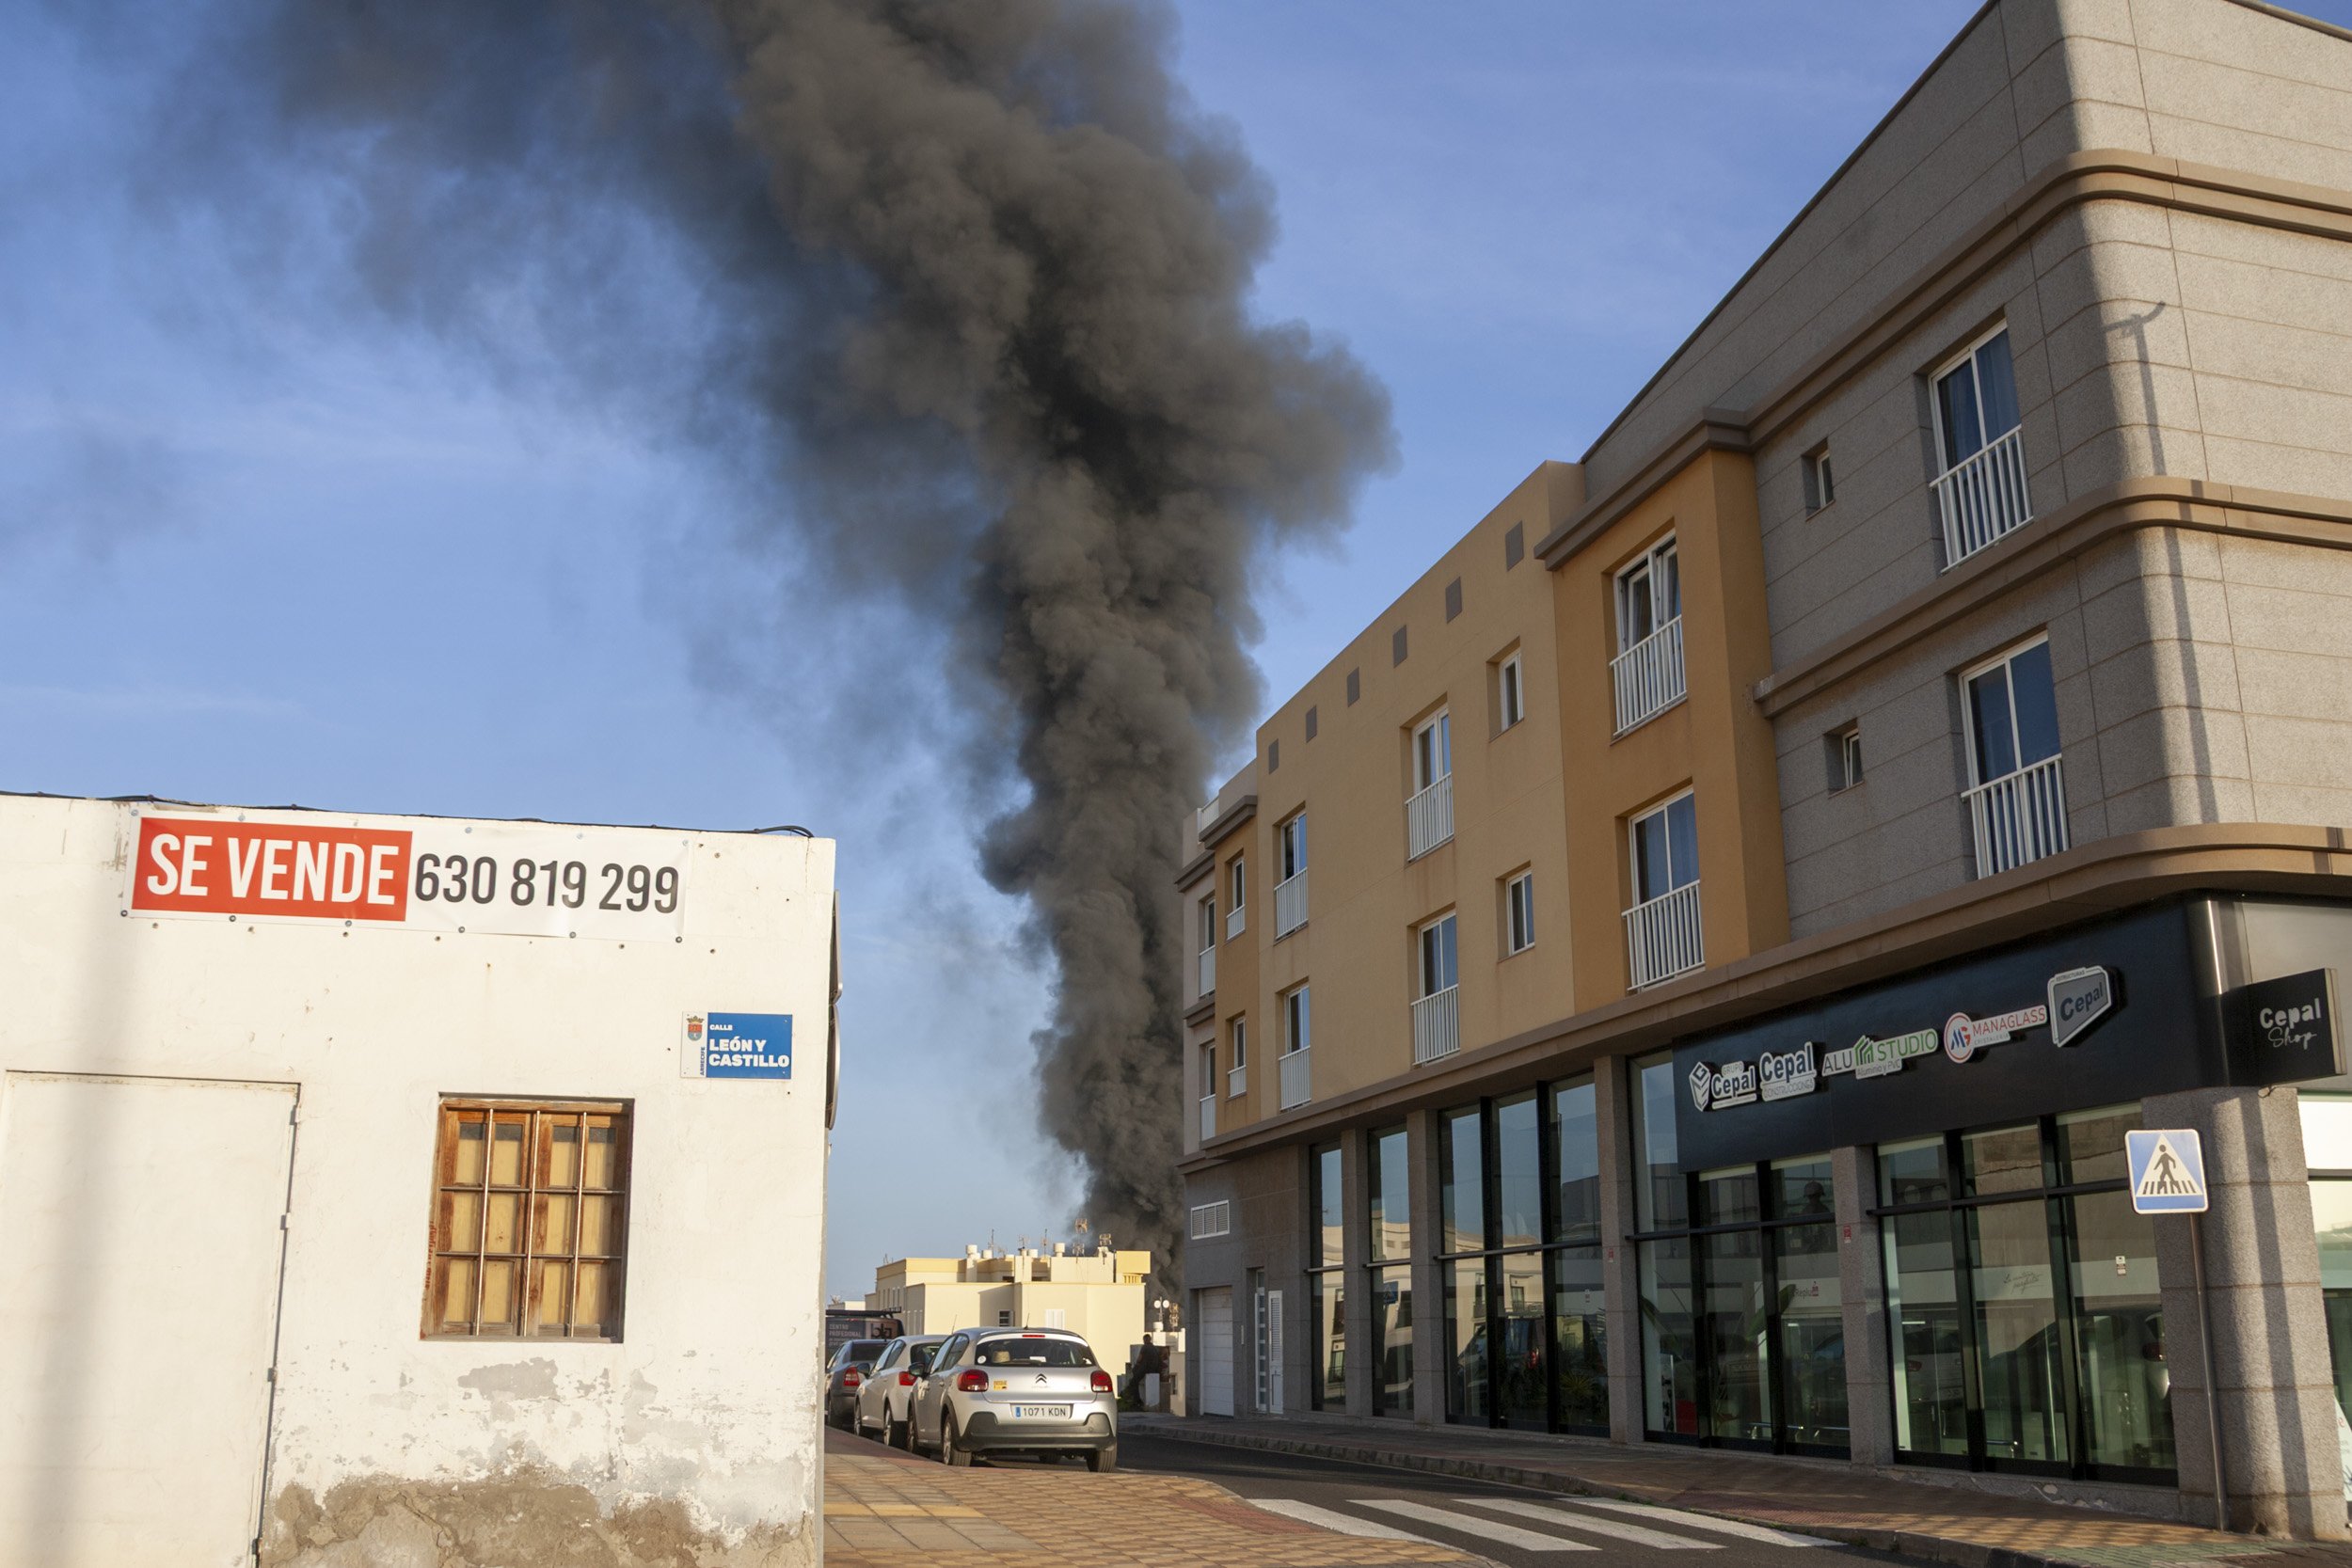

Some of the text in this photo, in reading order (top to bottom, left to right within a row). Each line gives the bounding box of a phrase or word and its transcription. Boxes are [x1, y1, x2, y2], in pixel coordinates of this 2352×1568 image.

[147, 833, 679, 914] SE VENDE 630 819 299
[2060, 982, 2103, 1022] Cepal
[2260, 998, 2321, 1029] Cepal
[1973, 1007, 2046, 1036] MANAGLASS
[708, 1036, 767, 1052] LEÓN Y
[1824, 1031, 1937, 1072] ALU STUDIO
[2268, 1027, 2317, 1050] Shop
[708, 1053, 790, 1068] CASTILLO
[1723, 1062, 1743, 1075] GRUPO
[1761, 1045, 1812, 1083] Cepal
[1888, 1058, 1900, 1069] PVC
[1712, 1068, 1755, 1097] Cepal
